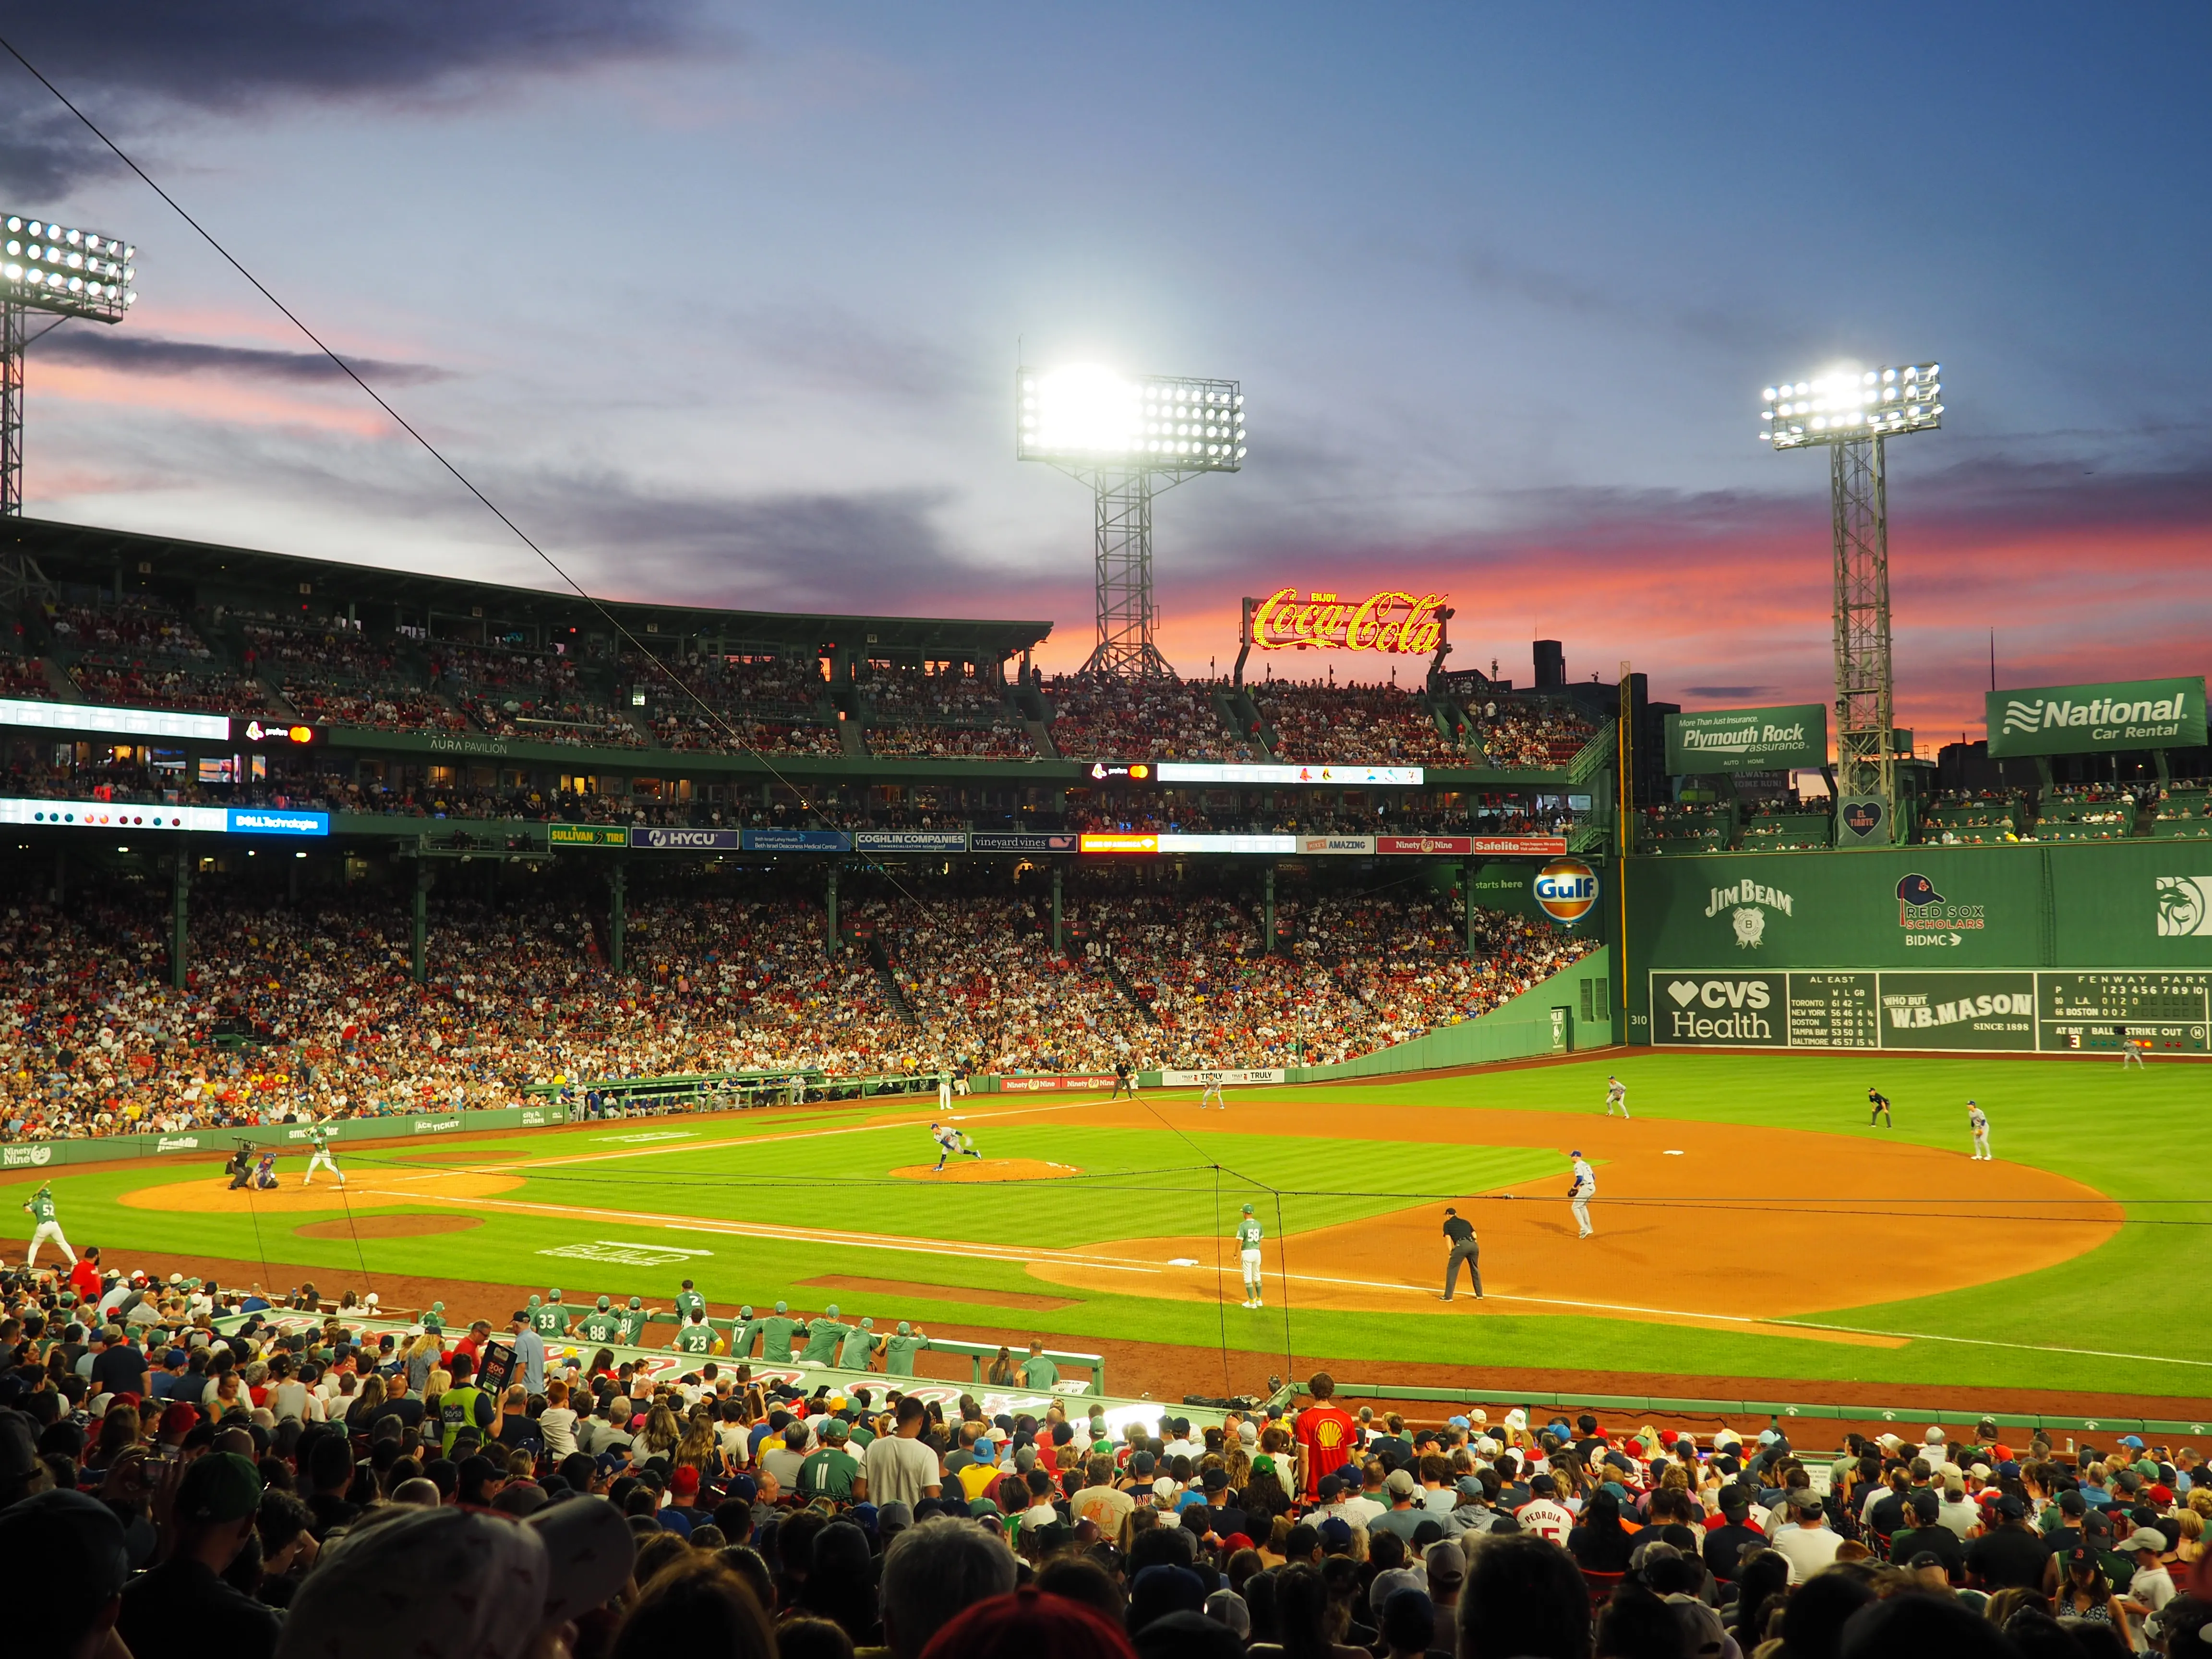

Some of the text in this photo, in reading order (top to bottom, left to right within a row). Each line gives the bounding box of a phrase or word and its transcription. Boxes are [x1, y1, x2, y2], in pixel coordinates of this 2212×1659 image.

[1311, 593, 1336, 602] ENJOY
[1252, 588, 1449, 652] Coca-Cola
[1727, 716, 1758, 724] Insurance.
[1683, 723, 1804, 749] Plymouth Rock
[2092, 723, 2178, 740] Car Rental
[465, 741, 507, 754] PAVILION
[1749, 741, 1805, 752] assurance
[552, 827, 625, 843] SULLIVAN TIRE
[671, 833, 714, 845] HYCU
[858, 835, 965, 843] COGHLIN COMPANIES
[975, 837, 1046, 848] vineyard vines
[1328, 841, 1366, 849] AMAZING
[1396, 841, 1420, 850] Ninety
[1476, 842, 1519, 850] Safelite
[1501, 880, 1523, 888] here
[1537, 878, 1594, 898] Gulf
[1705, 879, 1792, 917] JIM BEAM
[1906, 905, 1984, 918] RED SOX
[1745, 920, 1752, 928] B
[1906, 919, 1984, 929] SCHOLARS
[1906, 935, 1947, 946] BIDMC
[1701, 981, 1770, 1009] CVS
[2120, 986, 2127, 994] 3
[2131, 986, 2139, 994] 4
[1883, 996, 1927, 1006] WHO BUT
[1631, 1015, 1647, 1025] 310
[1672, 1011, 1772, 1038] Health
[2092, 1027, 2183, 1036] BALL STRIKE OUT
[2070, 1034, 2081, 1048] 3
[433, 1120, 459, 1131] TICKET
[3, 1147, 31, 1157] Ninety
[3, 1155, 30, 1165] Nine
[42, 1204, 55, 1216] 52
[1247, 1228, 1260, 1242] 58
[691, 1296, 700, 1306] 2
[539, 1314, 555, 1329] 33
[589, 1325, 606, 1341] 88
[733, 1327, 745, 1343] 17
[689, 1336, 707, 1352] 23
[488, 1362, 504, 1374] 300
[1525, 1511, 1561, 1524] PEDROIA
[2074, 1548, 2084, 1559] B
